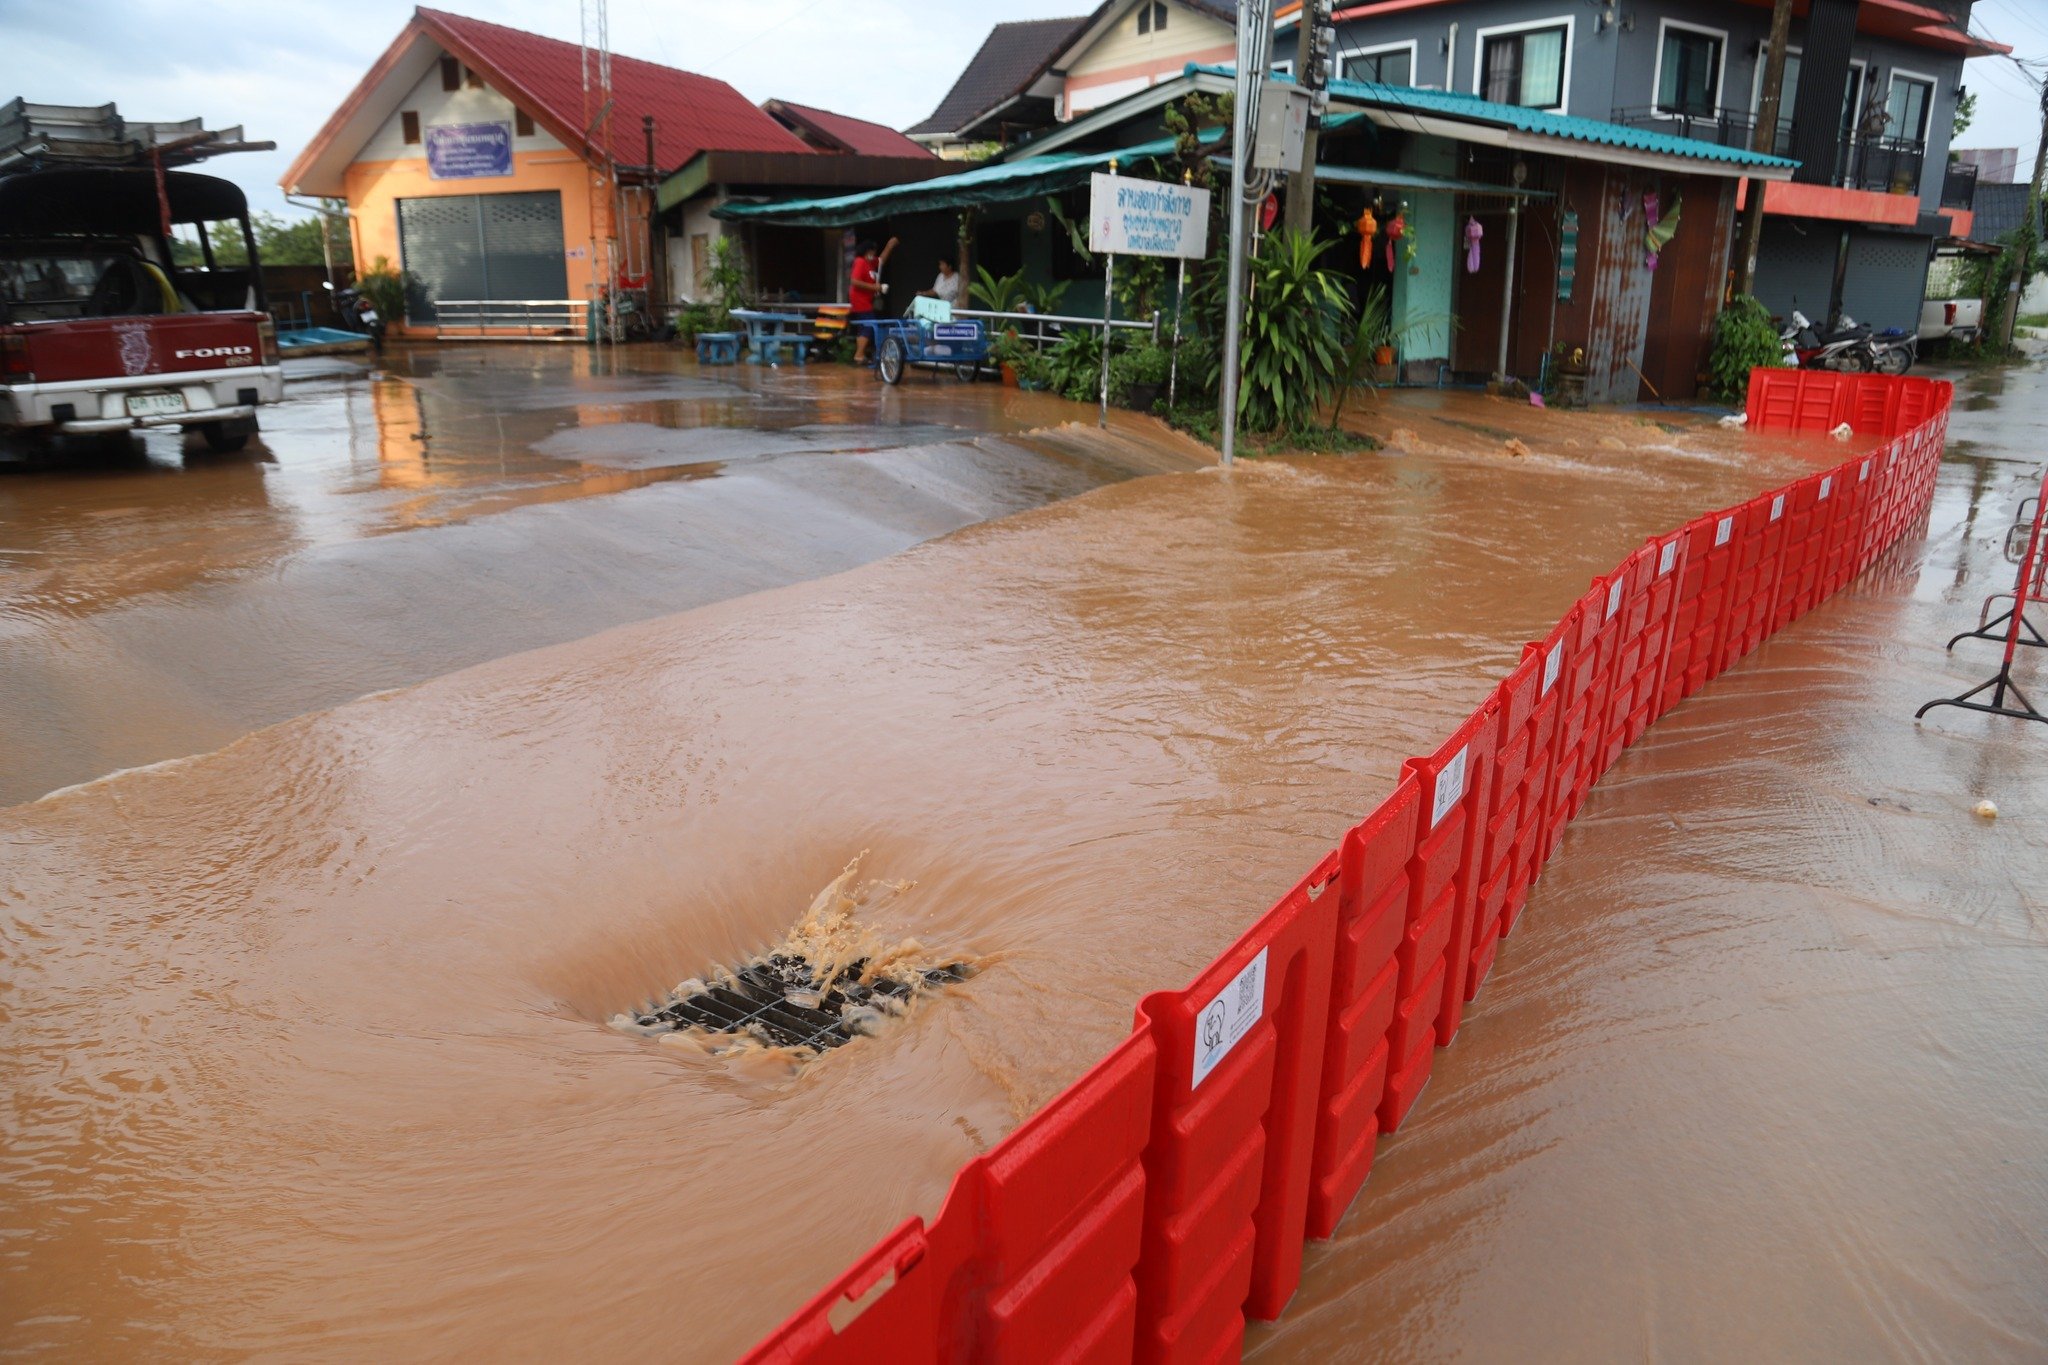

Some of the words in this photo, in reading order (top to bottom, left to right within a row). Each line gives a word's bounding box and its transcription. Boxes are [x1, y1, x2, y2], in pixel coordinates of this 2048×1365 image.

[1118, 186, 1191, 216] ลานออกกำลังกาย
[176, 346, 252, 359] FORD
